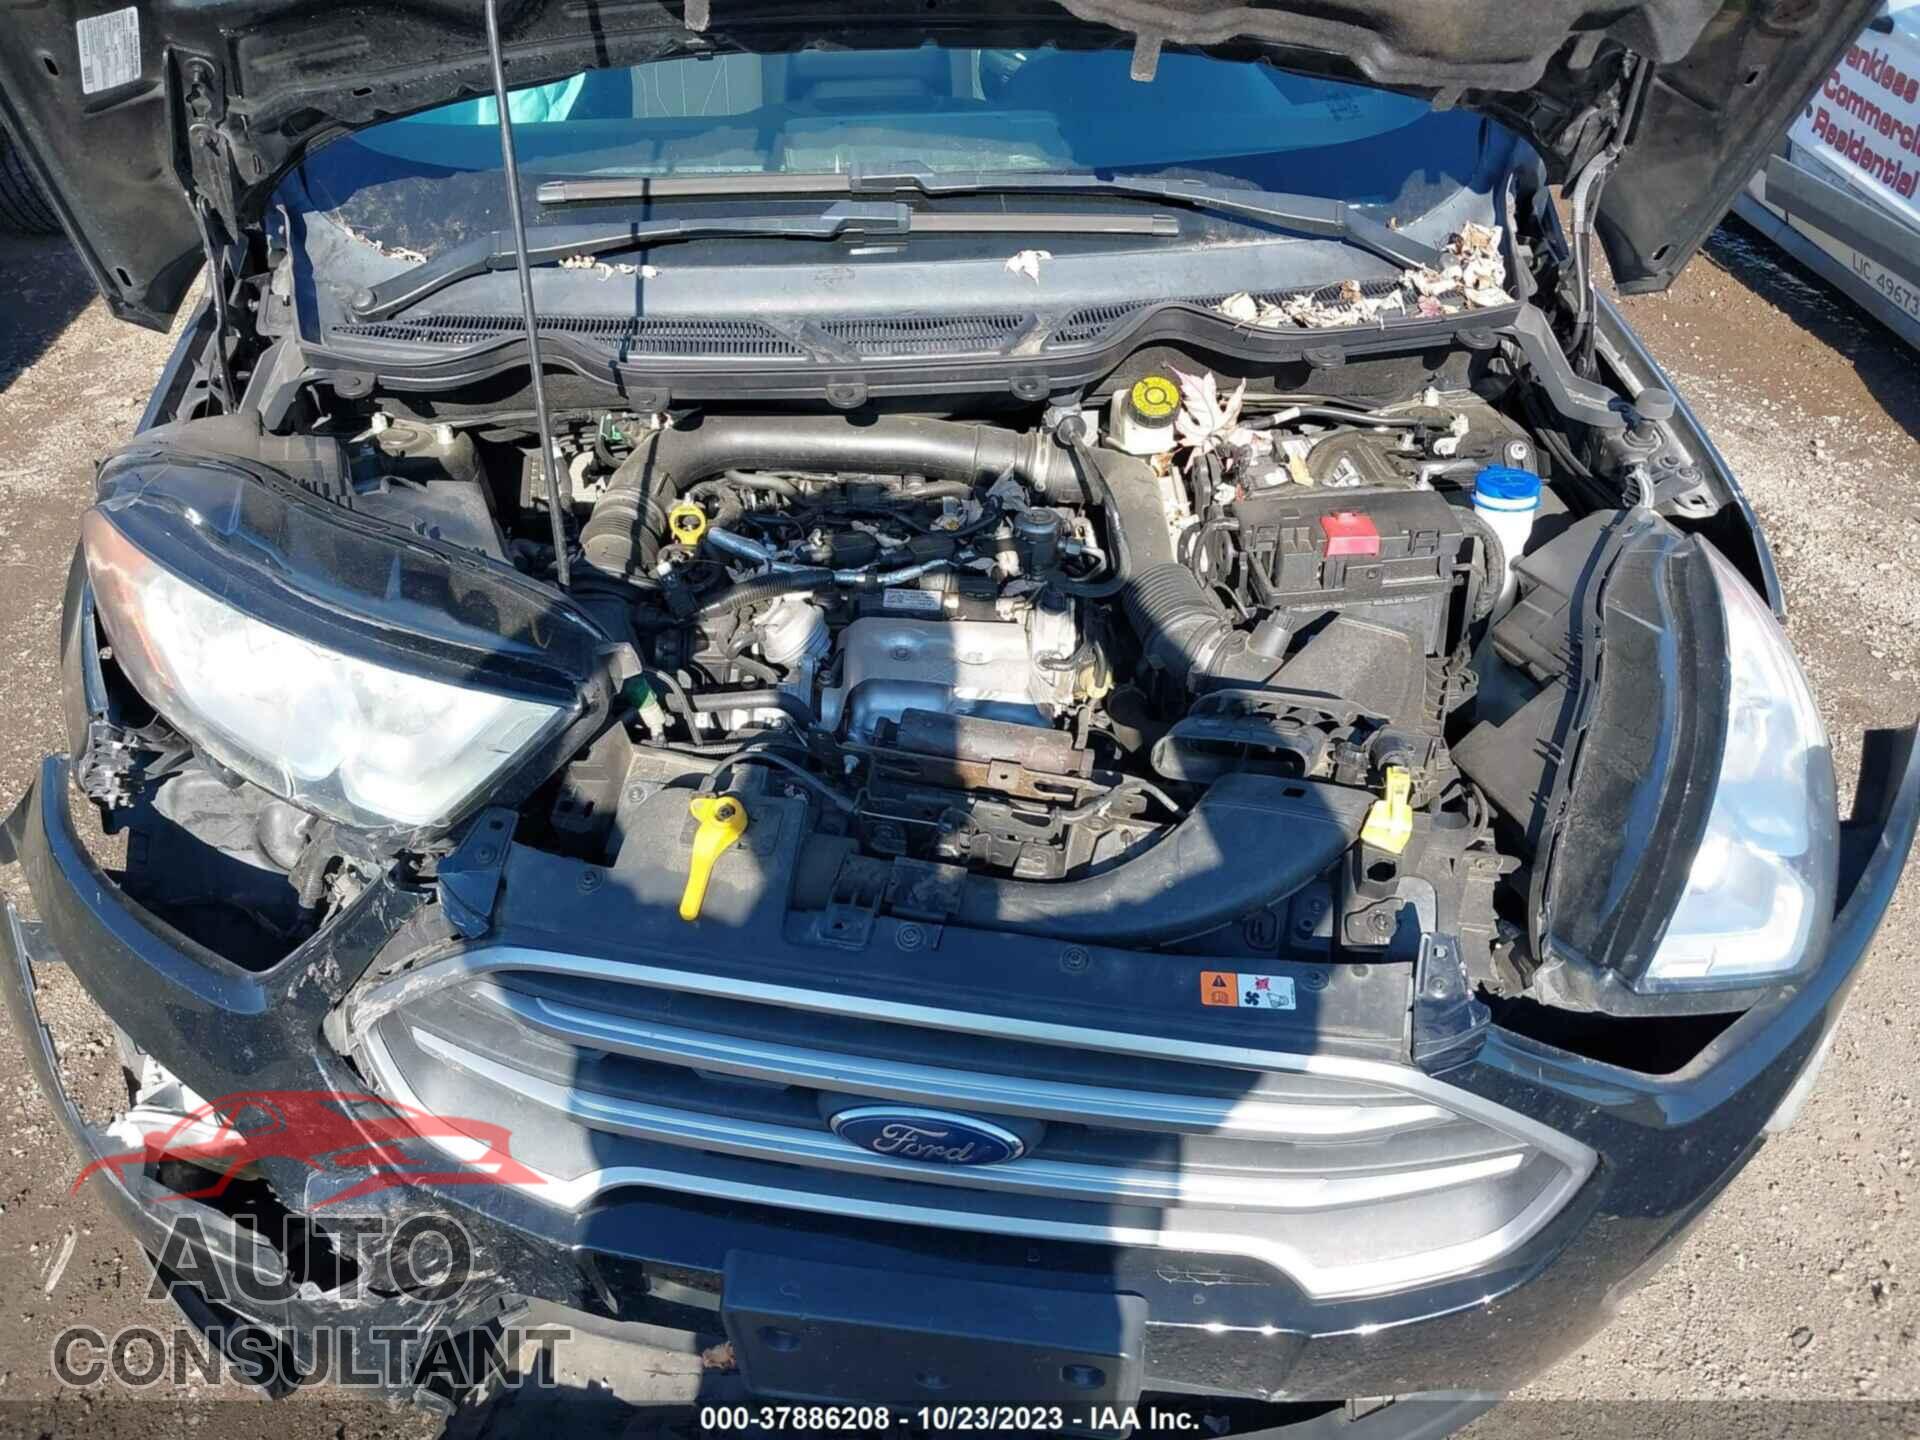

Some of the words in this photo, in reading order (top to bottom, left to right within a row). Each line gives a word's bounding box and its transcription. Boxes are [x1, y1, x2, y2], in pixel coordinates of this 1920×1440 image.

[1845, 47, 1920, 105] ankless
[1823, 69, 1920, 158] Commerci
[1811, 106, 1920, 200] Residential
[872, 1123, 976, 1162] Ford
